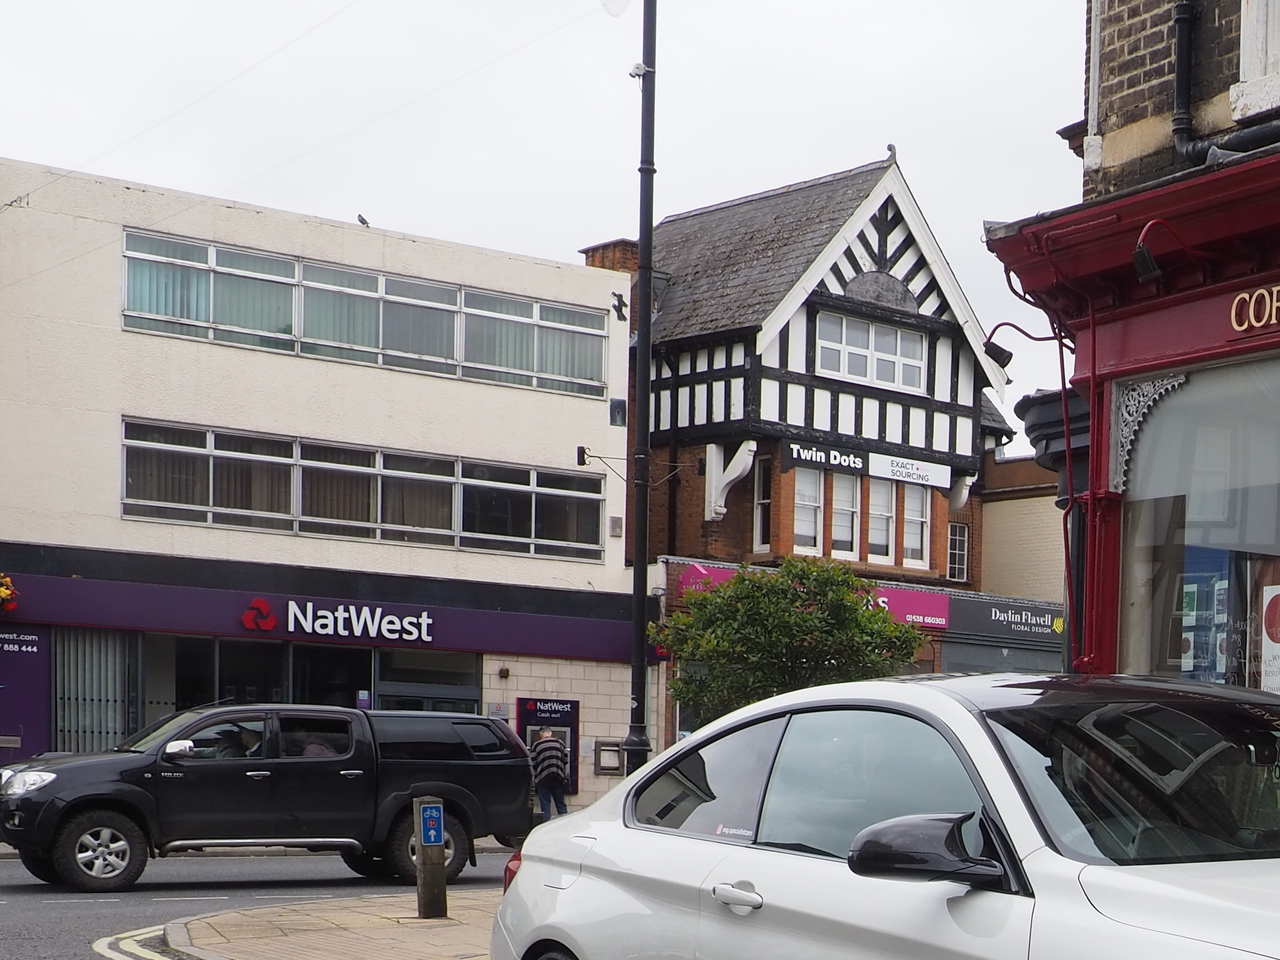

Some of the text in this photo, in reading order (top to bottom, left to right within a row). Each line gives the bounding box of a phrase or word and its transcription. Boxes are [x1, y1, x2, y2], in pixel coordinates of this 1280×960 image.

[789, 443, 863, 469] Twin Dots
[890, 460, 915, 471] EXACT
[890, 469, 930, 483] SOURCING
[287, 600, 433, 642] NatWest
[991, 608, 1052, 626] Daylin Flavell
[1011, 624, 1052, 634] FLORAL DESIGN
[536, 701, 572, 711] NatWest
